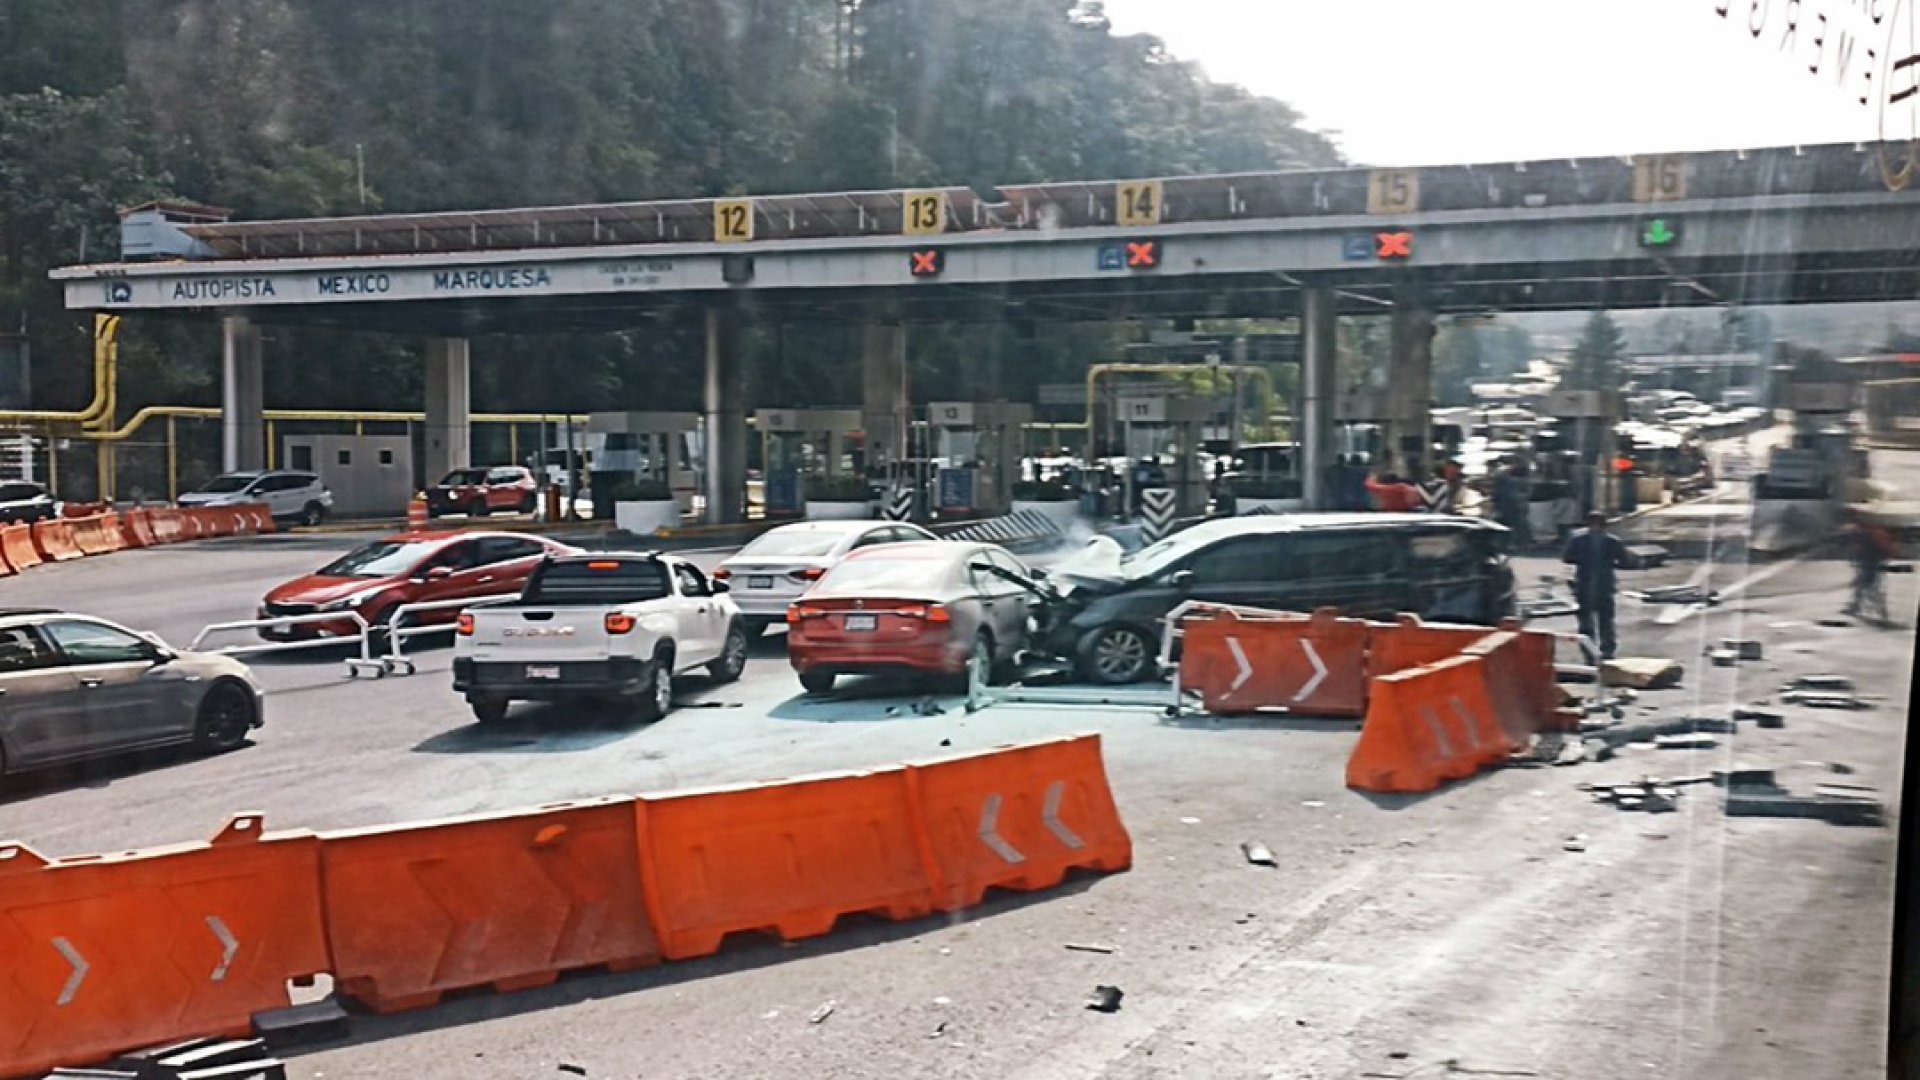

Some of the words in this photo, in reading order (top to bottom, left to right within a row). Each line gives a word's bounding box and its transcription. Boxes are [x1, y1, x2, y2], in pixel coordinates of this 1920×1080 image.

[1376, 173, 1409, 207] 15
[1647, 158, 1679, 193] 16
[911, 197, 939, 228] 13
[1123, 186, 1154, 219] 14
[720, 206, 747, 236] 12
[173, 278, 276, 299] AUTOPISTA
[318, 274, 391, 294] MEXICO
[433, 268, 551, 290] MARQUESA
